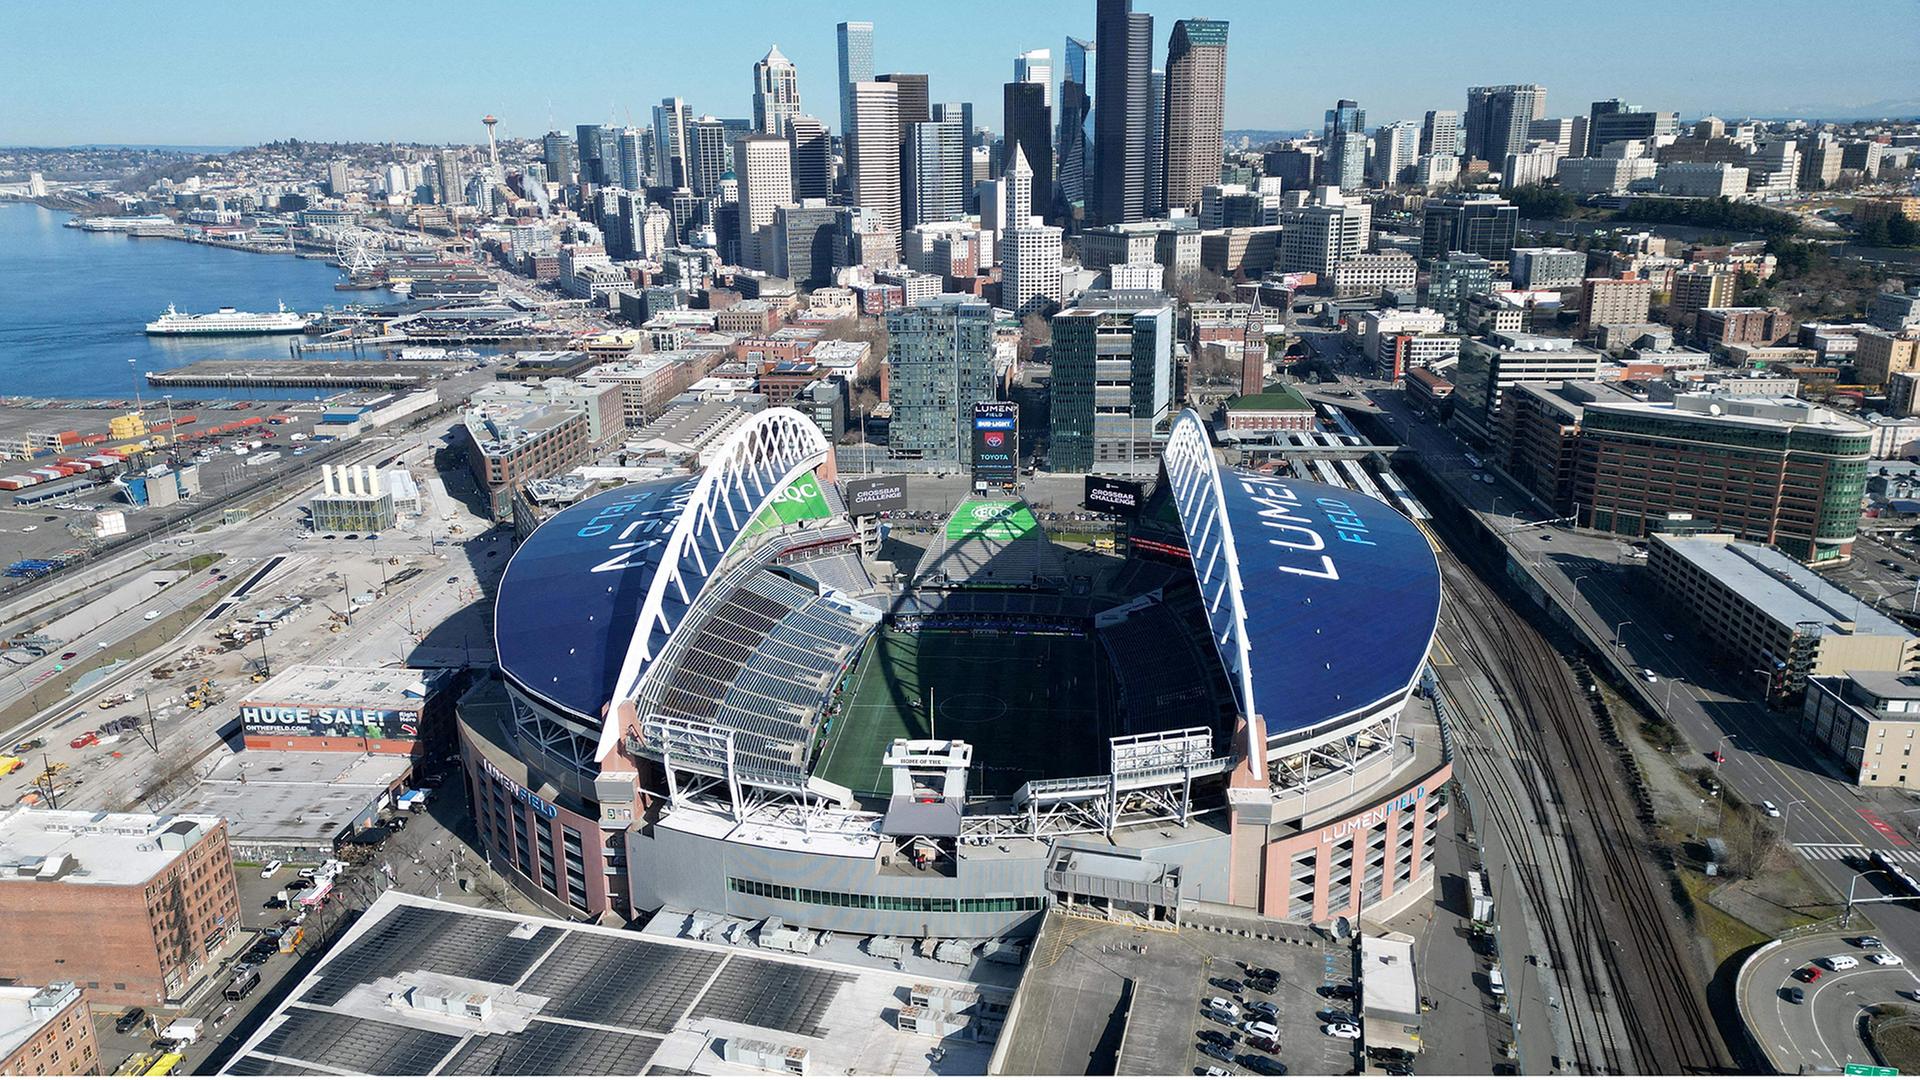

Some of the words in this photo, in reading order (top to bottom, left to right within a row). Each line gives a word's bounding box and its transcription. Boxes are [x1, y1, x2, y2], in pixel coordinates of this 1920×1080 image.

[855, 492, 902, 503] CHALLENGE
[857, 487, 900, 498] CROSSBAR
[1090, 493, 1136, 506] CHALLENGE
[1092, 488, 1134, 500] CROSSBAR
[577, 492, 656, 537] FIELD
[1233, 471, 1340, 580] LUMEN
[1316, 497, 1377, 546] FIELD
[243, 707, 311, 724] HUGE
[319, 709, 385, 727] SALE!
[483, 759, 518, 796] LUMEN
[520, 787, 558, 818] FIELD
[1322, 808, 1384, 843] LUMEN
[1386, 786, 1425, 816] FIELD
